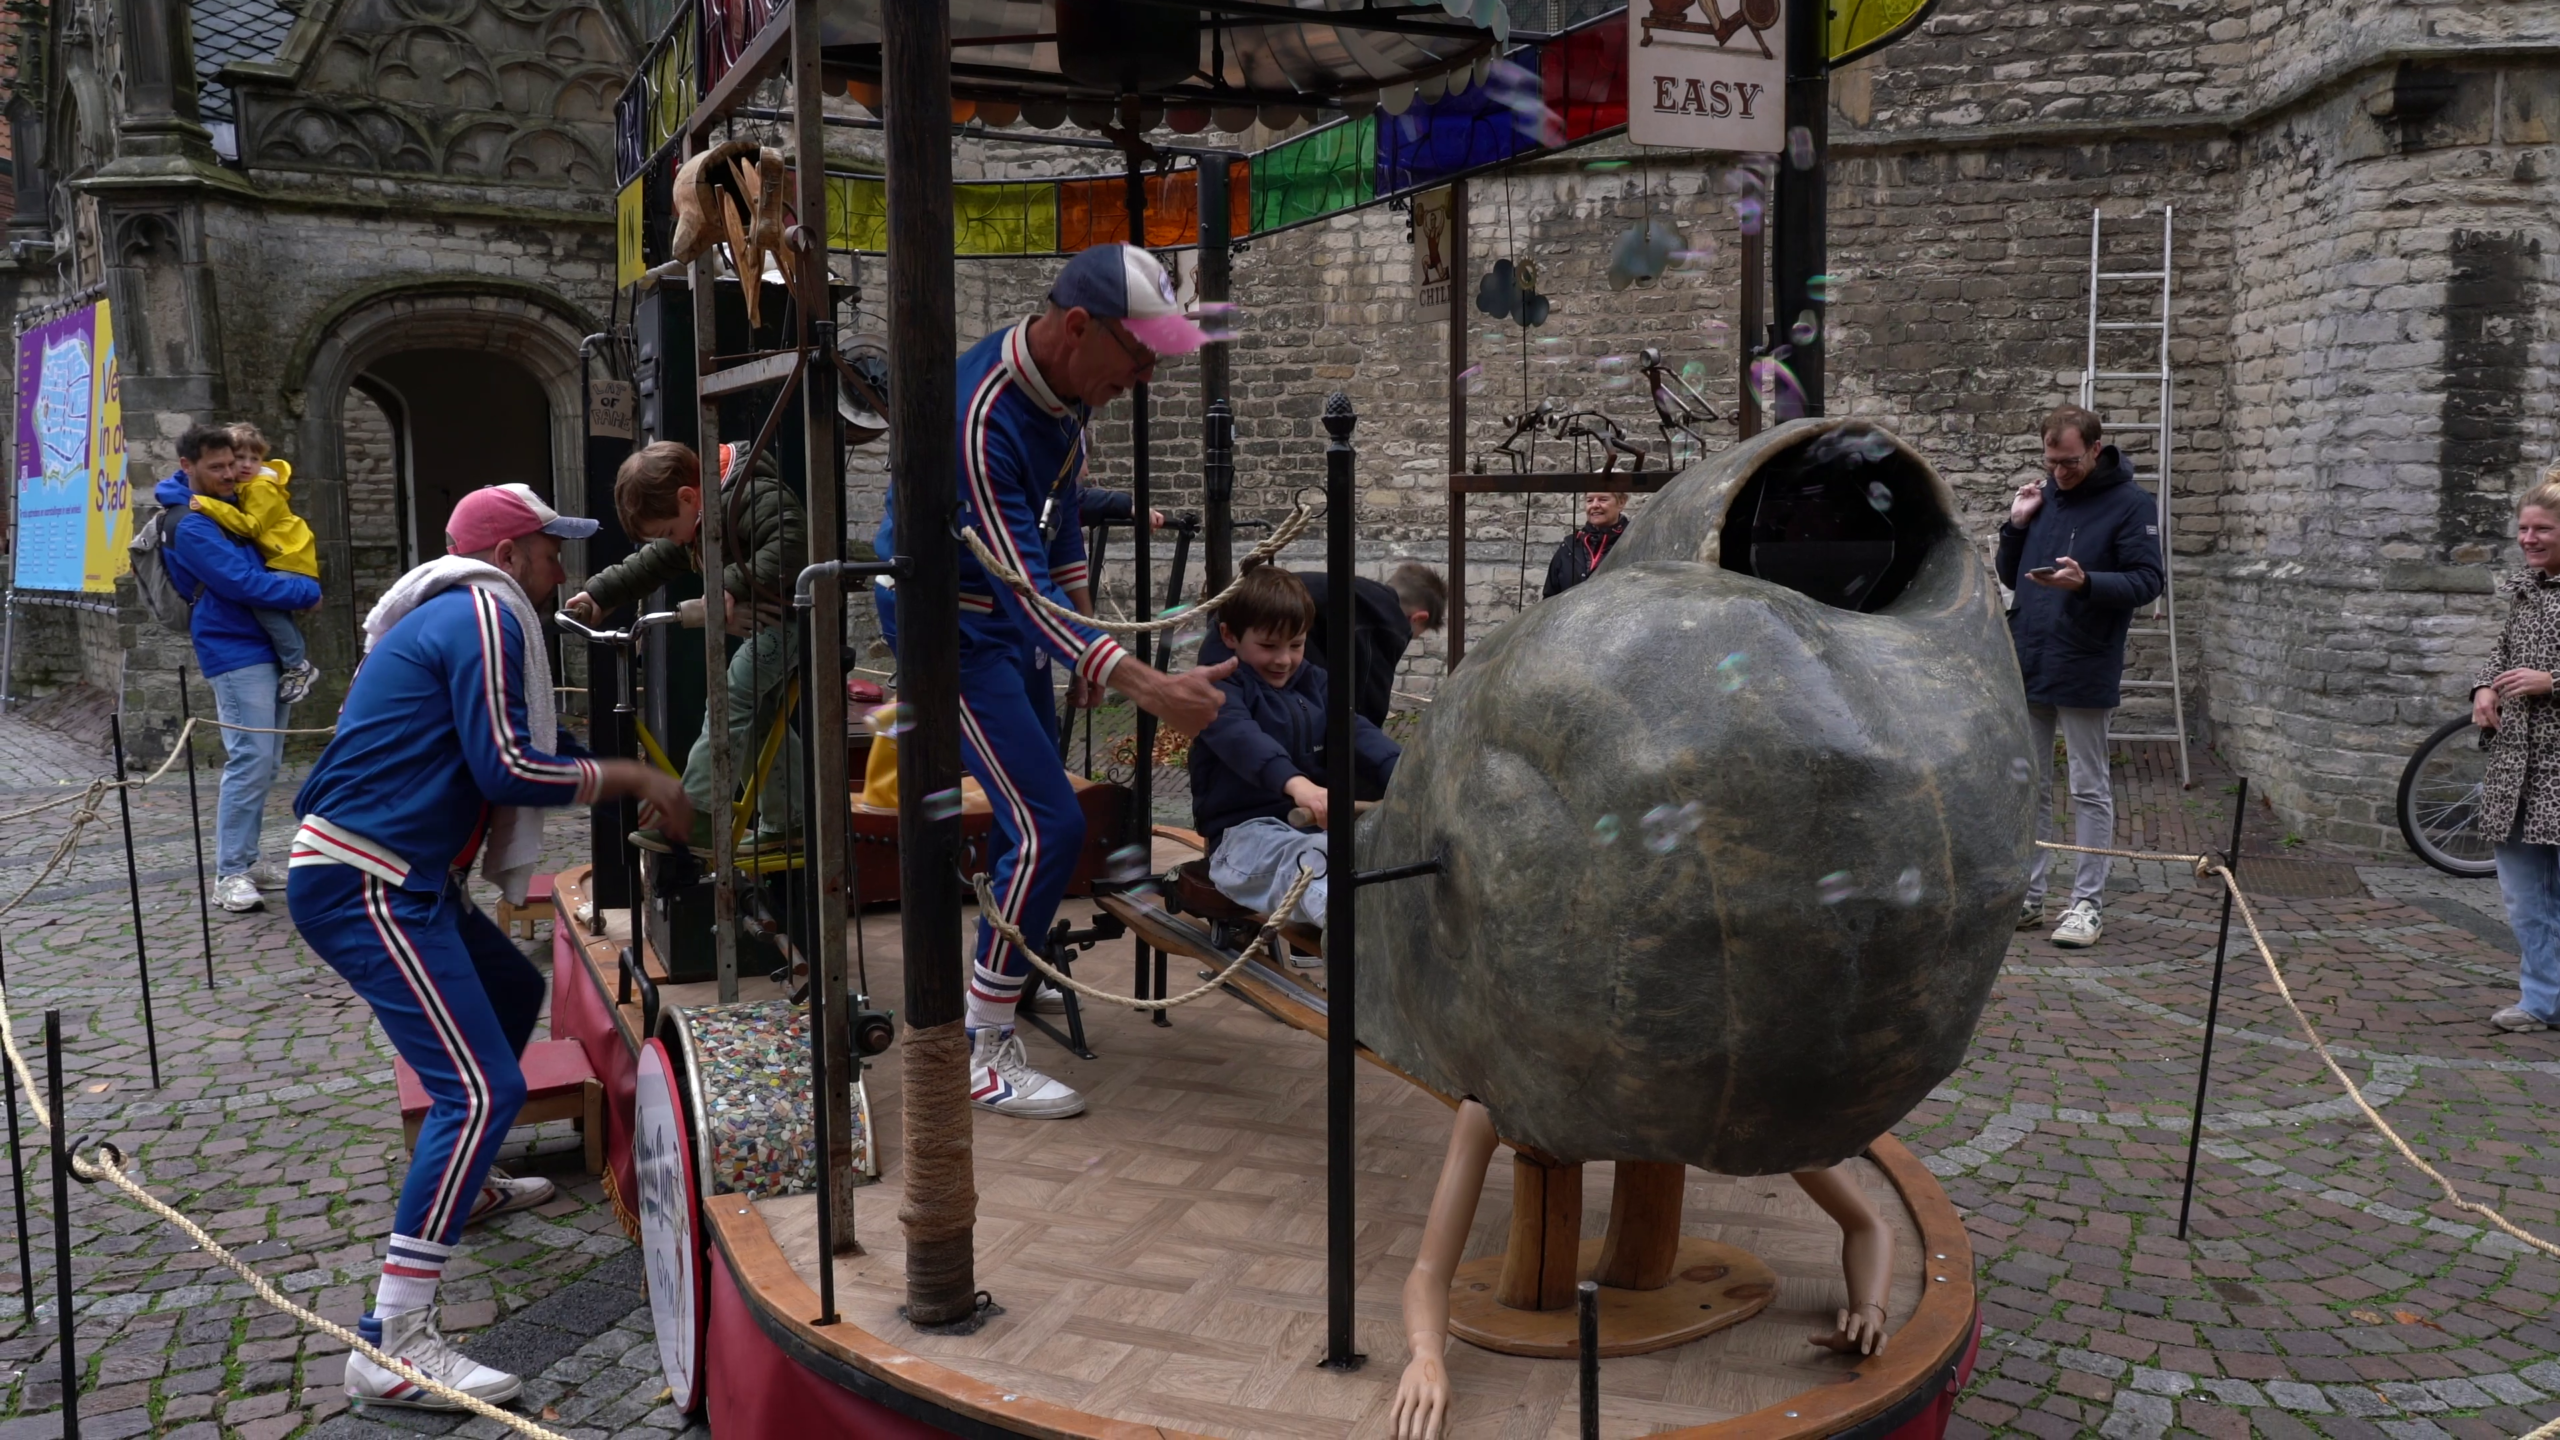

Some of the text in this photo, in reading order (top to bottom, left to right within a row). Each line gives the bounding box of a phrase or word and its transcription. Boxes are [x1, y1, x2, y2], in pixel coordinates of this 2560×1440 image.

[1652, 75, 1764, 120] EASY
[623, 205, 635, 266] IN
[592, 382, 627, 396] LAT
[600, 397, 620, 409] OF
[99, 416, 110, 458] in
[591, 408, 632, 432] FAME
[96, 468, 128, 512] Stad
